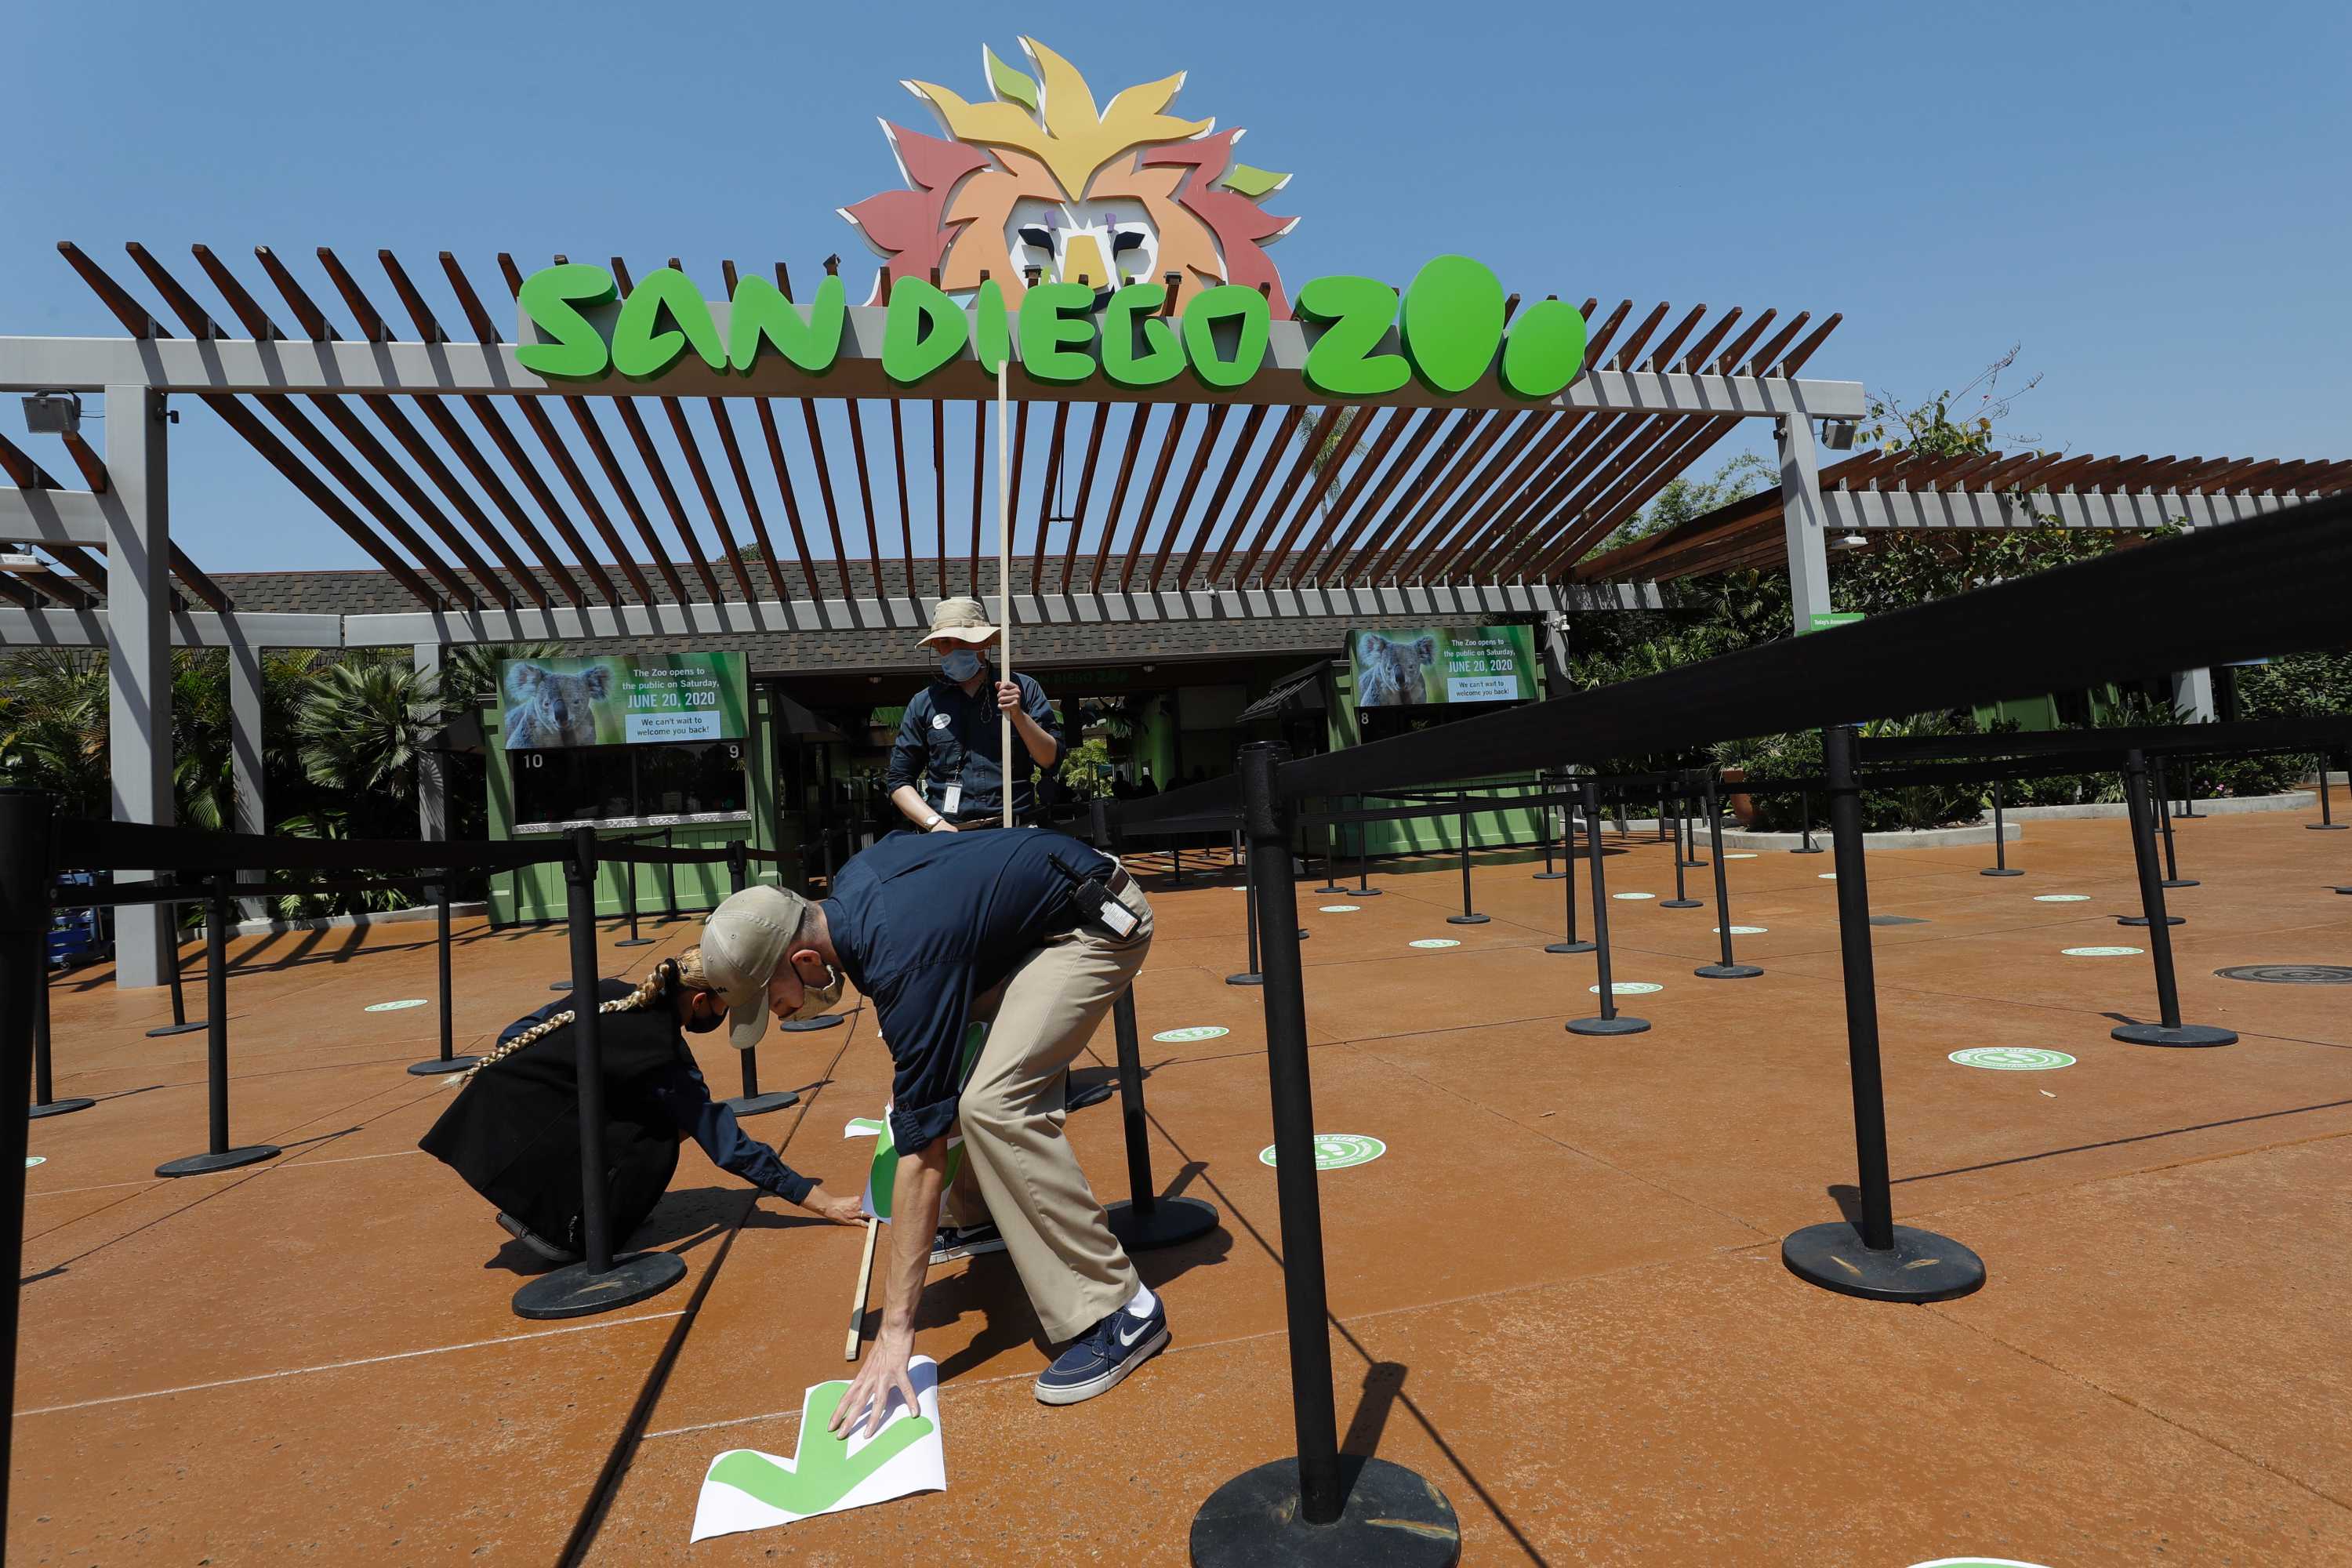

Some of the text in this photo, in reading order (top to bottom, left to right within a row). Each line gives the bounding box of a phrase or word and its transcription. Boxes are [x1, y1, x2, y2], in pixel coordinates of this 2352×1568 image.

[514, 254, 1587, 400] SAN DIEGO ZOO
[1448, 659, 1512, 673] JUNE 20, 2020
[633, 669, 649, 677] The
[639, 681, 664, 691] public
[681, 679, 720, 688] Saturday,
[627, 691, 715, 709] JUNE 20, 2020
[1361, 712, 1369, 724] 8
[729, 746, 739, 758] 9
[524, 754, 543, 768] 10
